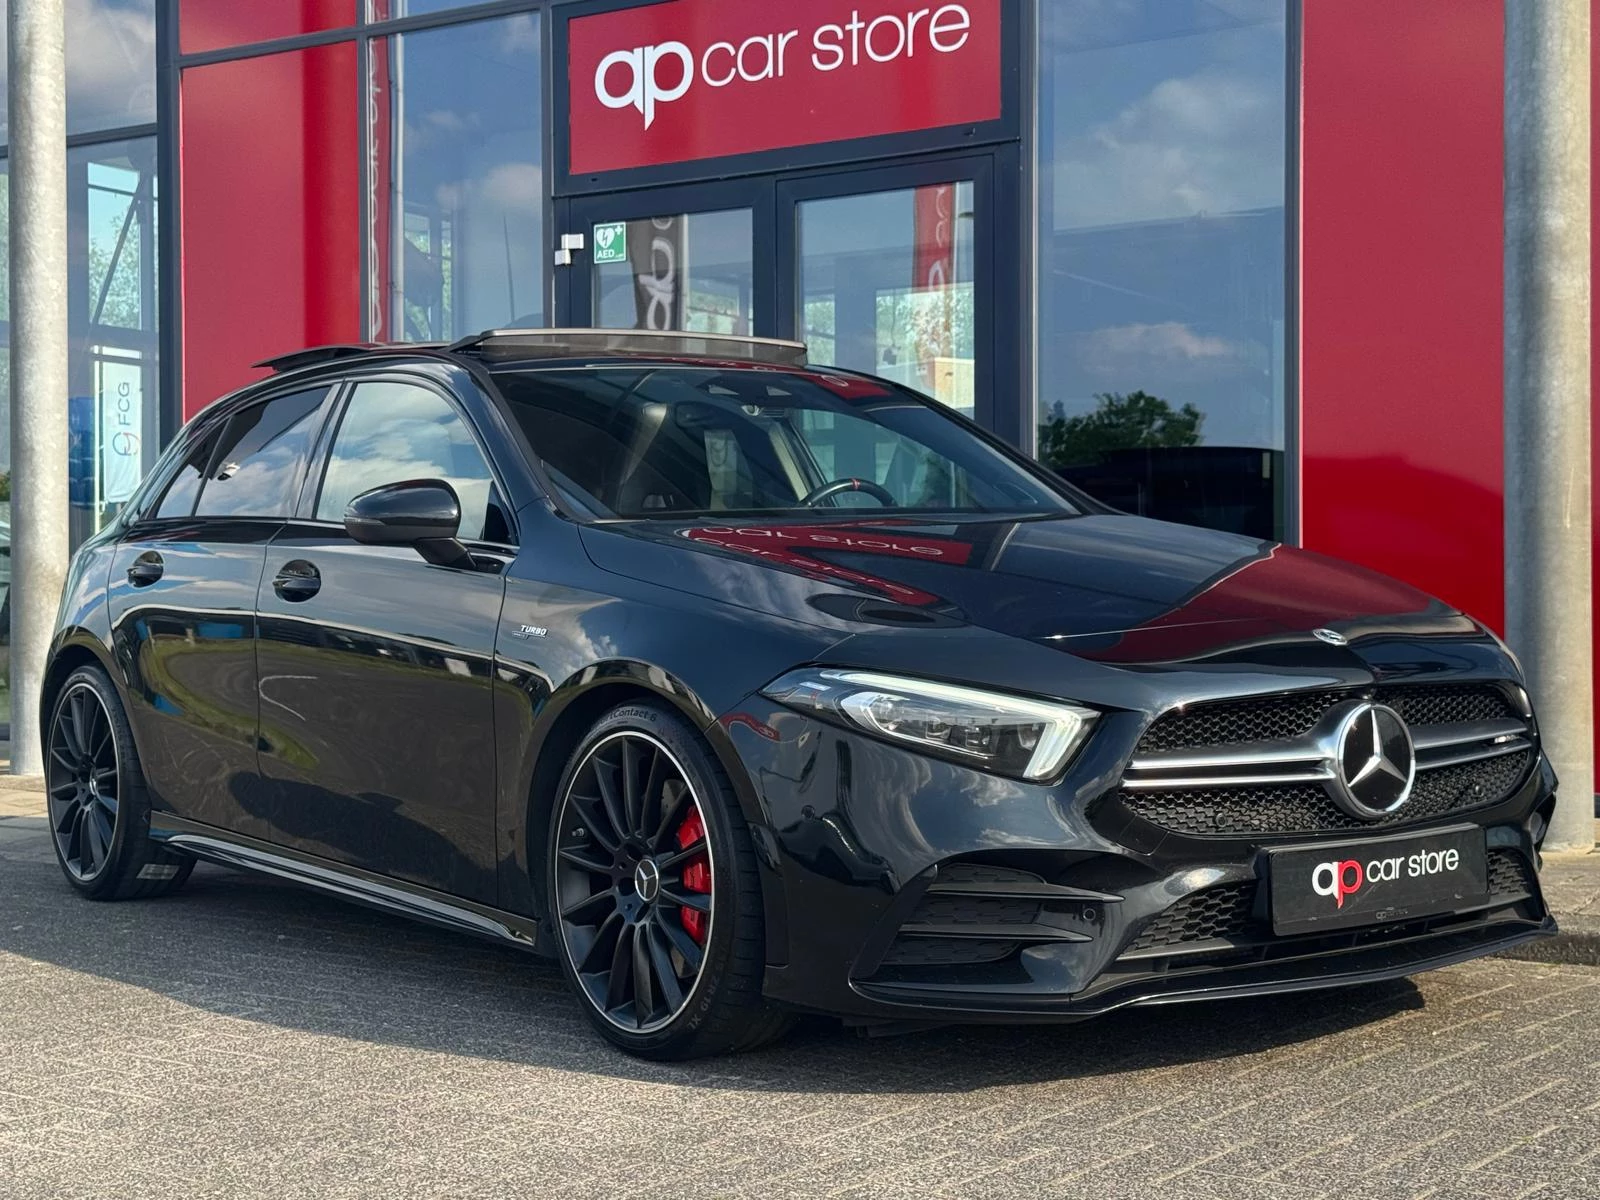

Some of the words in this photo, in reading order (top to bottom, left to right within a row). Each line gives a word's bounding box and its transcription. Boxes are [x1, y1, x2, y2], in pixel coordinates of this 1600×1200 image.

[702, 31, 798, 86] car
[812, 4, 970, 71] store
[597, 249, 615, 259] AED
[118, 382, 130, 425] FCG
[520, 624, 547, 636] TURBO
[1366, 856, 1405, 882] car
[1408, 848, 1460, 876] store
